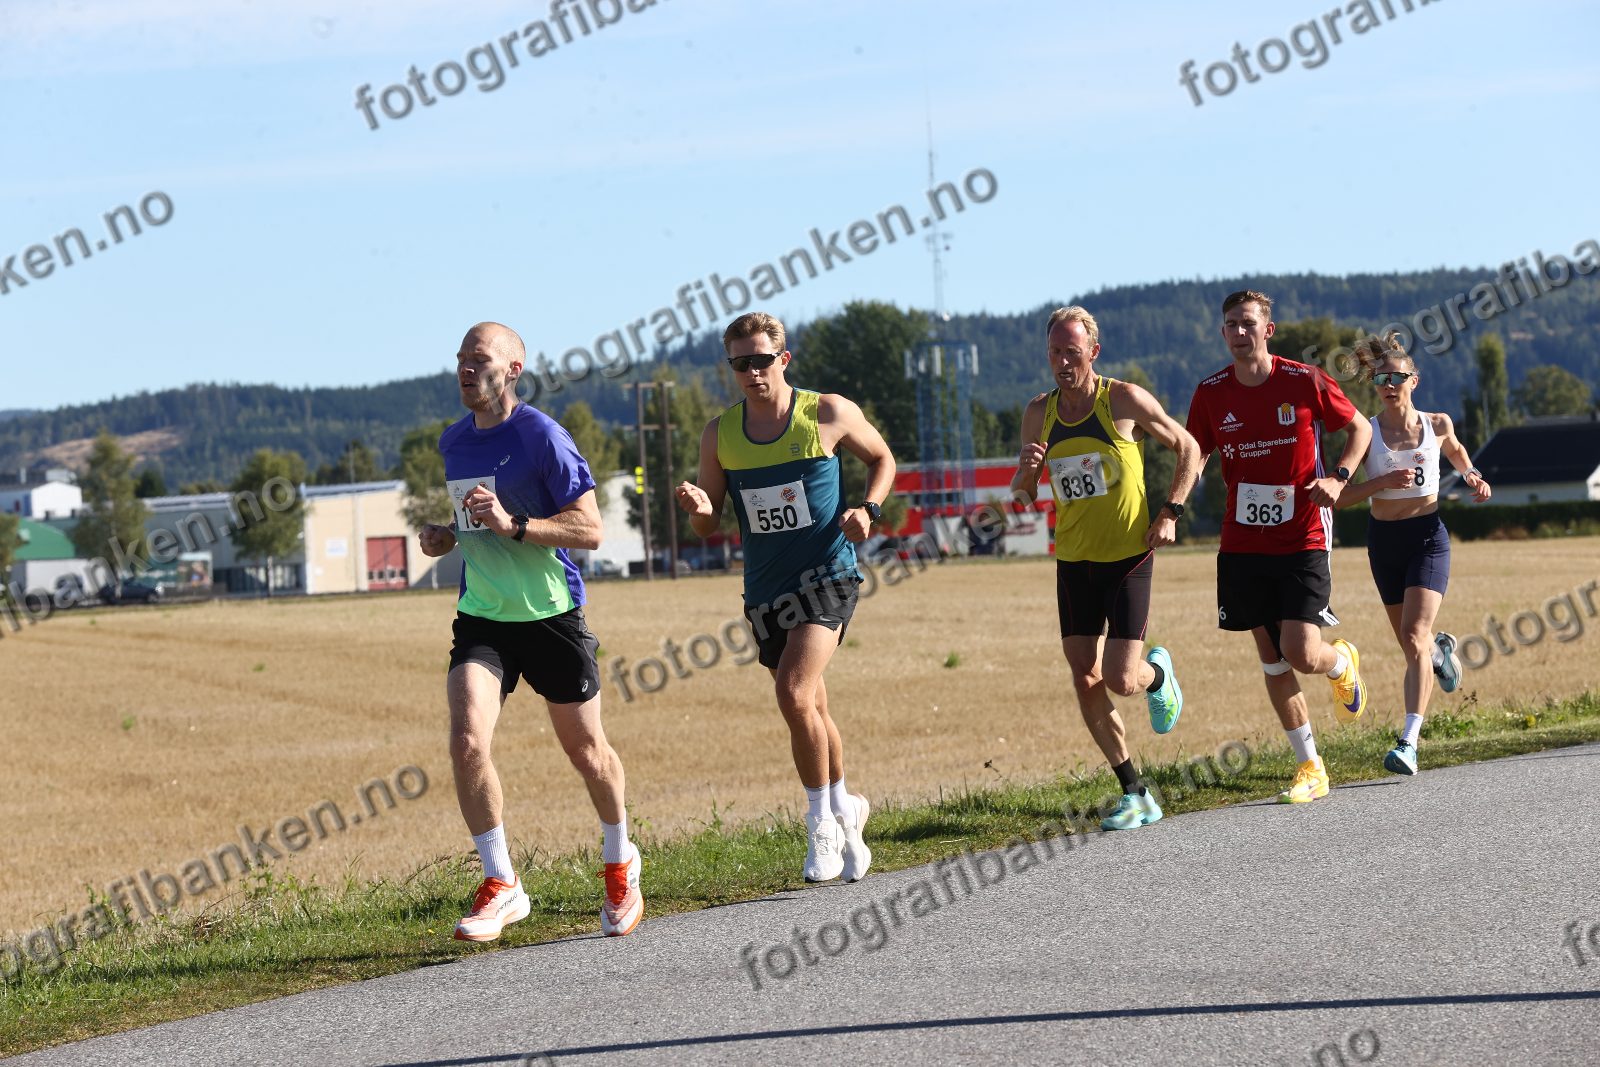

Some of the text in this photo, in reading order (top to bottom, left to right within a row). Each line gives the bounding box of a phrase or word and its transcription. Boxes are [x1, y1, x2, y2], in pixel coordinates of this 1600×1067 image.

[1238, 435, 1298, 451] Odal Sparebank
[1239, 448, 1271, 459] Gruppen
[1061, 473, 1096, 499] 838
[756, 504, 798, 532] 550
[1246, 502, 1283, 524] 363
